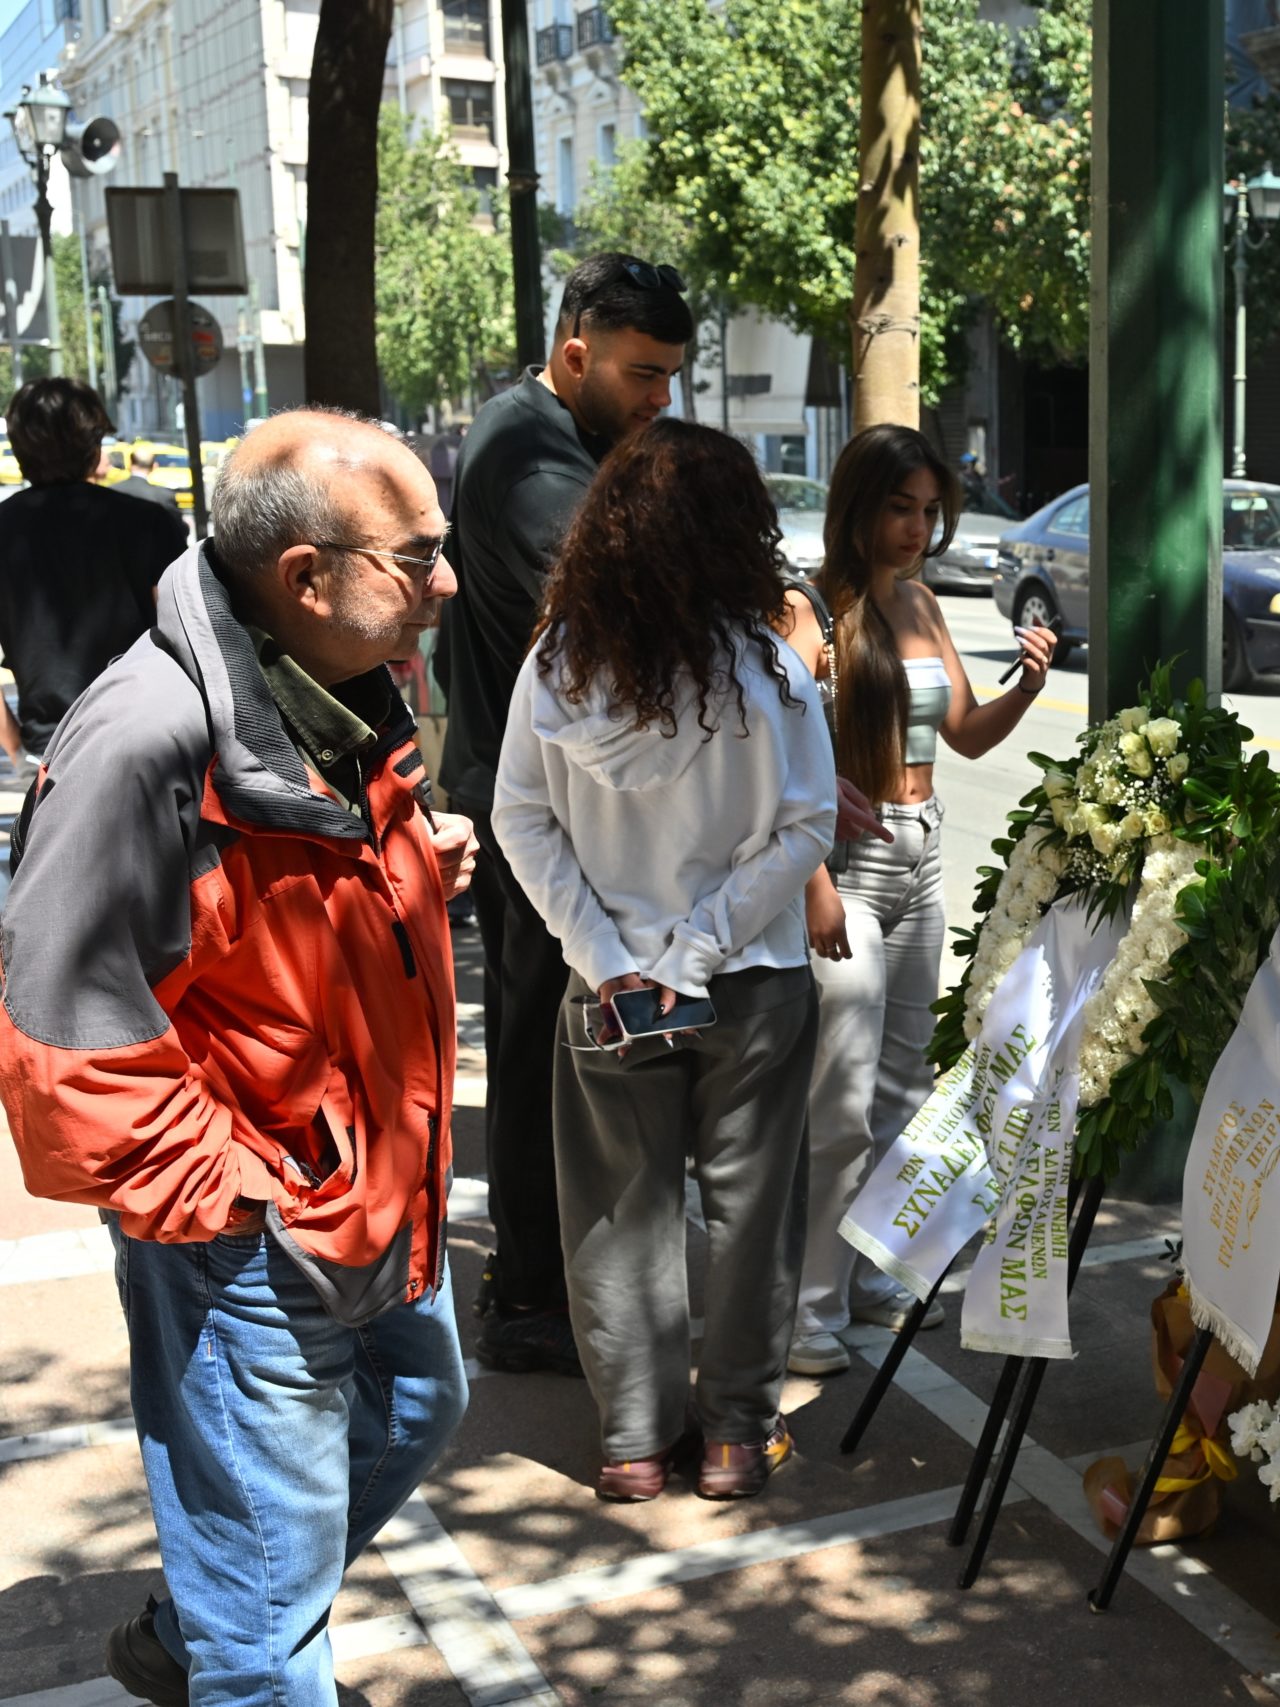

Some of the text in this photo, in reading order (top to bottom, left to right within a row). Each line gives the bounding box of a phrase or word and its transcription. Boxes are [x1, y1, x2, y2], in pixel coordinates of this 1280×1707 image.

[989, 1023, 1037, 1085] ΜΑΣ
[896, 1043, 992, 1186] ΤΩΝ ΔΙΚΟΧΑΜΕΝΩΝ
[1048, 1101, 1061, 1132] ΤΩΝ
[1210, 1099, 1275, 1230] ΕΡΓΑΖΟΜΕΝΩΝ
[1032, 1148, 1059, 1279] ΑΔΙΚΟΧΑΜΕΝΩΝ
[1052, 1197, 1067, 1258] ΜΝΗΜΗ
[1001, 1257, 1027, 1321] ΜΑΣ
